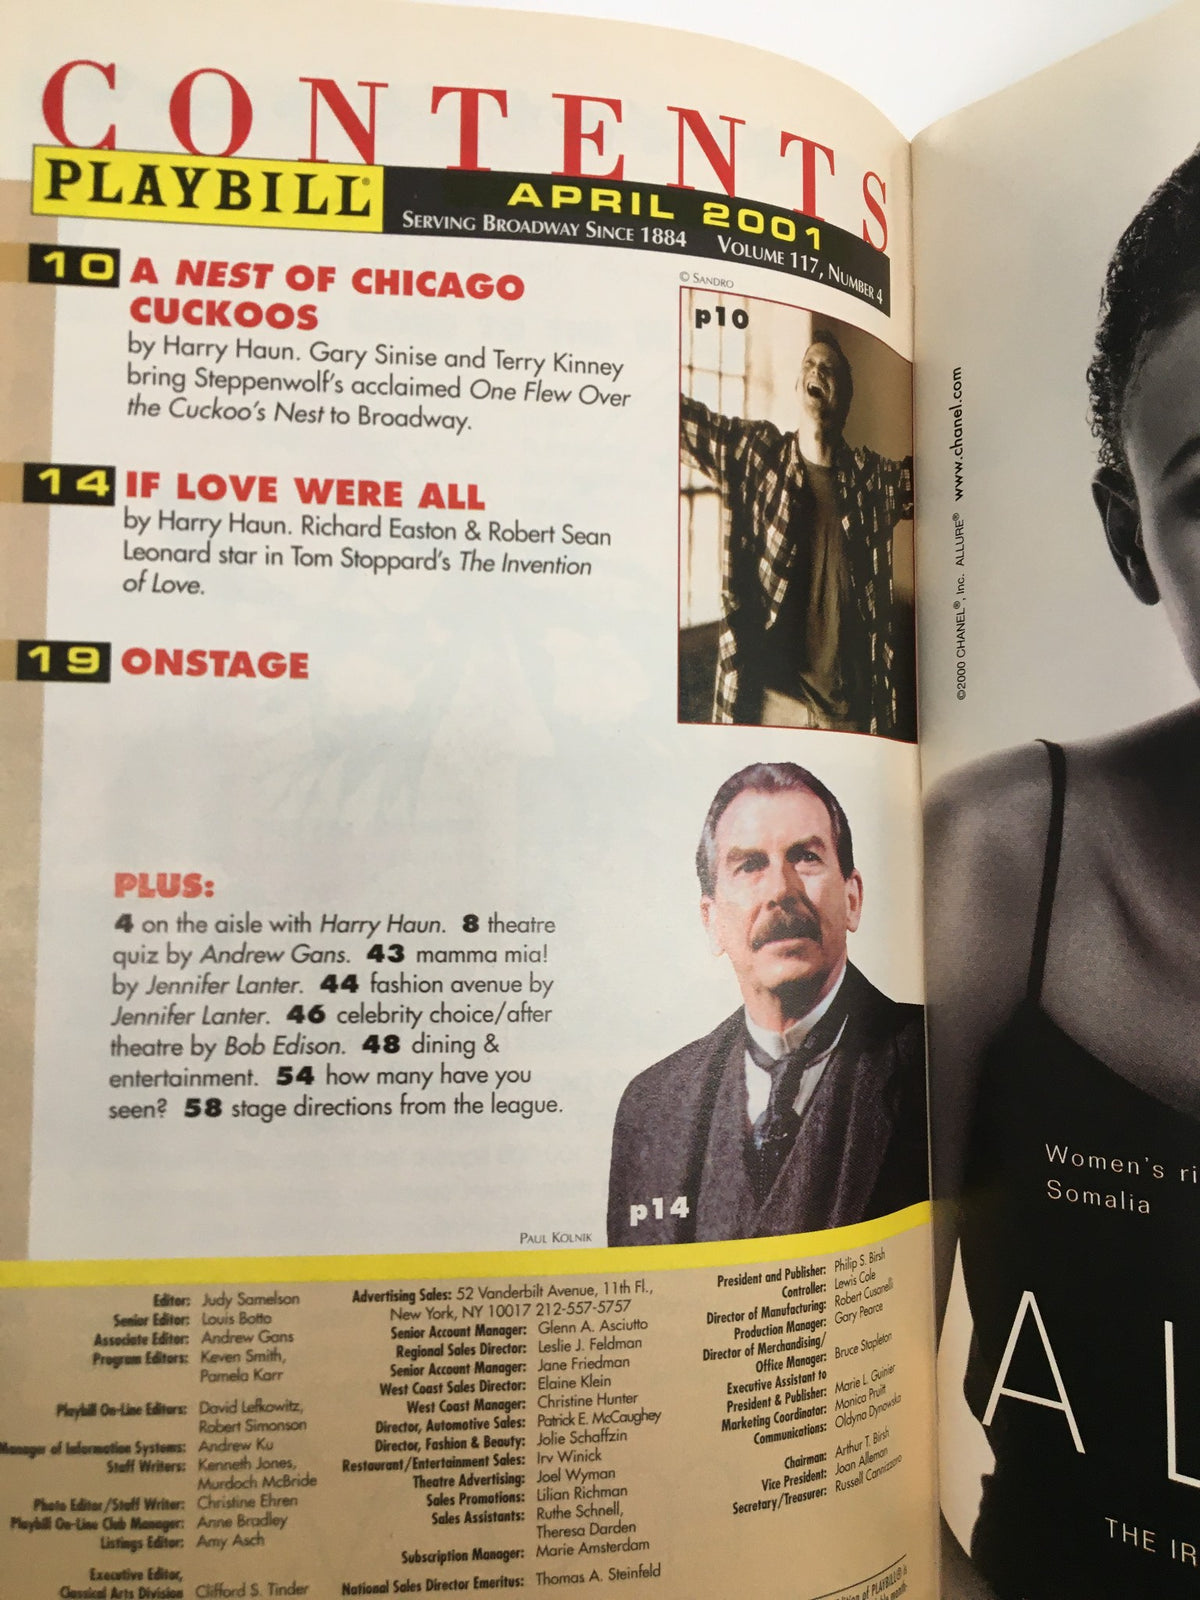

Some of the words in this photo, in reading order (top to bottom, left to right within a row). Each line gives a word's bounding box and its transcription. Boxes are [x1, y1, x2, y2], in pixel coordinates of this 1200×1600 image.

[42, 59, 888, 252] CONTENTS
[507, 182, 675, 220] APRIL
[703, 201, 821, 250] 2001
[43, 250, 115, 280] 10
[130, 257, 158, 284] A
[176, 259, 273, 290] NEST
[285, 265, 337, 292] OF
[351, 268, 525, 301] CHICAGO
[641, 226, 687, 248] 1884
[790, 251, 824, 280] 117,
[876, 288, 883, 304] 4
[130, 296, 318, 330] CUCKOOS
[695, 306, 749, 329] p10
[128, 330, 156, 358] by
[164, 335, 228, 363] Harry
[236, 338, 301, 361] Haun.
[310, 341, 368, 369] Gary
[375, 343, 437, 367] Sinise
[445, 347, 486, 369] and
[493, 348, 546, 377] Terry
[553, 352, 624, 382] Kinney
[127, 362, 186, 392] bring
[351, 371, 461, 398] acclaimed
[470, 379, 517, 401] One
[523, 381, 572, 403] Flew
[579, 385, 631, 407] Over
[127, 394, 161, 417] the
[169, 395, 266, 422] Cuckoo's
[275, 401, 325, 424] Nest
[330, 407, 351, 425] to
[359, 403, 472, 435] Broadway.
[949, 367, 963, 501] www.chanel.com
[38, 468, 110, 497] 14
[126, 471, 160, 498] IF
[178, 474, 278, 504] LOVE
[294, 476, 403, 508] WERE
[418, 482, 486, 510] ALL
[124, 508, 151, 536] by
[158, 511, 222, 538] Harry
[228, 514, 292, 536] Haun.
[302, 514, 382, 538] Richard
[389, 518, 456, 541] Easton
[465, 520, 482, 542] &
[488, 519, 556, 544] Robert
[562, 524, 612, 546] Sean
[124, 541, 210, 564] Leonard
[219, 546, 257, 566] star
[265, 546, 284, 566] in
[291, 546, 333, 568] Tom
[459, 552, 495, 573] The
[502, 553, 592, 576] Invention
[122, 570, 148, 594] of
[152, 574, 206, 595] Love.
[956, 573, 965, 595] Inc.
[28, 646, 100, 674] 19
[122, 648, 309, 680] ONSTAGE
[115, 873, 214, 898] PLUS:
[114, 914, 133, 933] 4
[142, 918, 169, 933] on
[176, 912, 208, 933] the
[215, 912, 262, 934] aisle
[269, 912, 312, 933] with
[320, 914, 380, 938] Harry
[388, 915, 446, 933] Haun.
[462, 915, 479, 933] 8
[488, 912, 556, 933] theatre
[113, 946, 159, 969] quiz
[166, 942, 192, 968] by
[200, 944, 284, 964] Andrew
[292, 944, 351, 964] Gans.
[367, 944, 404, 963] 43
[417, 948, 497, 963] mamma
[504, 944, 548, 963] mia!
[113, 973, 138, 998] by
[145, 974, 229, 994] Jennifer
[236, 975, 303, 994] Lanter.
[320, 974, 358, 993] 44
[370, 972, 443, 993] fashion
[451, 978, 522, 993] avenue
[530, 972, 554, 998] by
[110, 1005, 195, 1026] Jennifer
[202, 1006, 270, 1025] Lanter.
[286, 1005, 325, 1023] 46
[337, 1002, 422, 1027] celebrity
[429, 1002, 552, 1026] choice/after
[111, 1036, 183, 1057] theatre
[191, 1034, 217, 1060] by
[224, 1036, 265, 1055] Bob
[274, 1035, 346, 1055] Edison.
[362, 1035, 399, 1054] 48
[411, 1032, 476, 1057] dining
[484, 1037, 499, 1053] &
[109, 1068, 258, 1087] entertainment.
[276, 1067, 314, 1085] 54
[326, 1064, 369, 1085] how
[377, 1068, 433, 1090] many
[440, 1063, 488, 1085] have
[495, 1069, 531, 1089] you
[109, 1099, 167, 1119] seen?
[184, 1098, 222, 1118] 58
[231, 1100, 286, 1122] stage
[294, 1094, 392, 1116] directions
[400, 1093, 446, 1115] from
[454, 1092, 483, 1114] the
[491, 1091, 563, 1117] league.
[1045, 1144, 1164, 1178] Women's
[1047, 1180, 1151, 1214] Somalia
[630, 1196, 689, 1226] p14
[717, 1272, 762, 1287] President
[765, 1269, 781, 1282] and
[785, 1265, 826, 1280] Publisher:
[834, 1274, 856, 1289] Lewis
[859, 1269, 876, 1283] Cole
[202, 1294, 232, 1310] Judy
[237, 1292, 300, 1306] Samelson
[352, 1289, 415, 1304] Advertising
[419, 1288, 451, 1301] Sales:
[456, 1287, 473, 1299] 52
[478, 1284, 543, 1299] Vanderbilt
[548, 1284, 598, 1298] Avenue,
[390, 1308, 421, 1321] New
[426, 1306, 458, 1321] York,
[462, 1306, 483, 1318] NY
[488, 1304, 530, 1317] 10017
[536, 1300, 631, 1316] 212-557-5757
[202, 1331, 254, 1344] Andrew
[259, 1330, 294, 1343] Gans
[538, 1360, 566, 1372] Jane
[572, 1356, 630, 1370] Friedman
[537, 1470, 561, 1484] Joel
[566, 1468, 615, 1484] Wyman
[762, 1479, 780, 1492] Vice
[784, 1468, 827, 1487] President:
[733, 1487, 827, 1515] Secretary/Treasurer:
[196, 1536, 228, 1550] Amy
[232, 1533, 265, 1546] Asch
[1105, 1517, 1157, 1553] THE
[536, 1571, 584, 1586] Thomas
[589, 1570, 603, 1582] A.
[608, 1563, 661, 1581] Steinfeld
